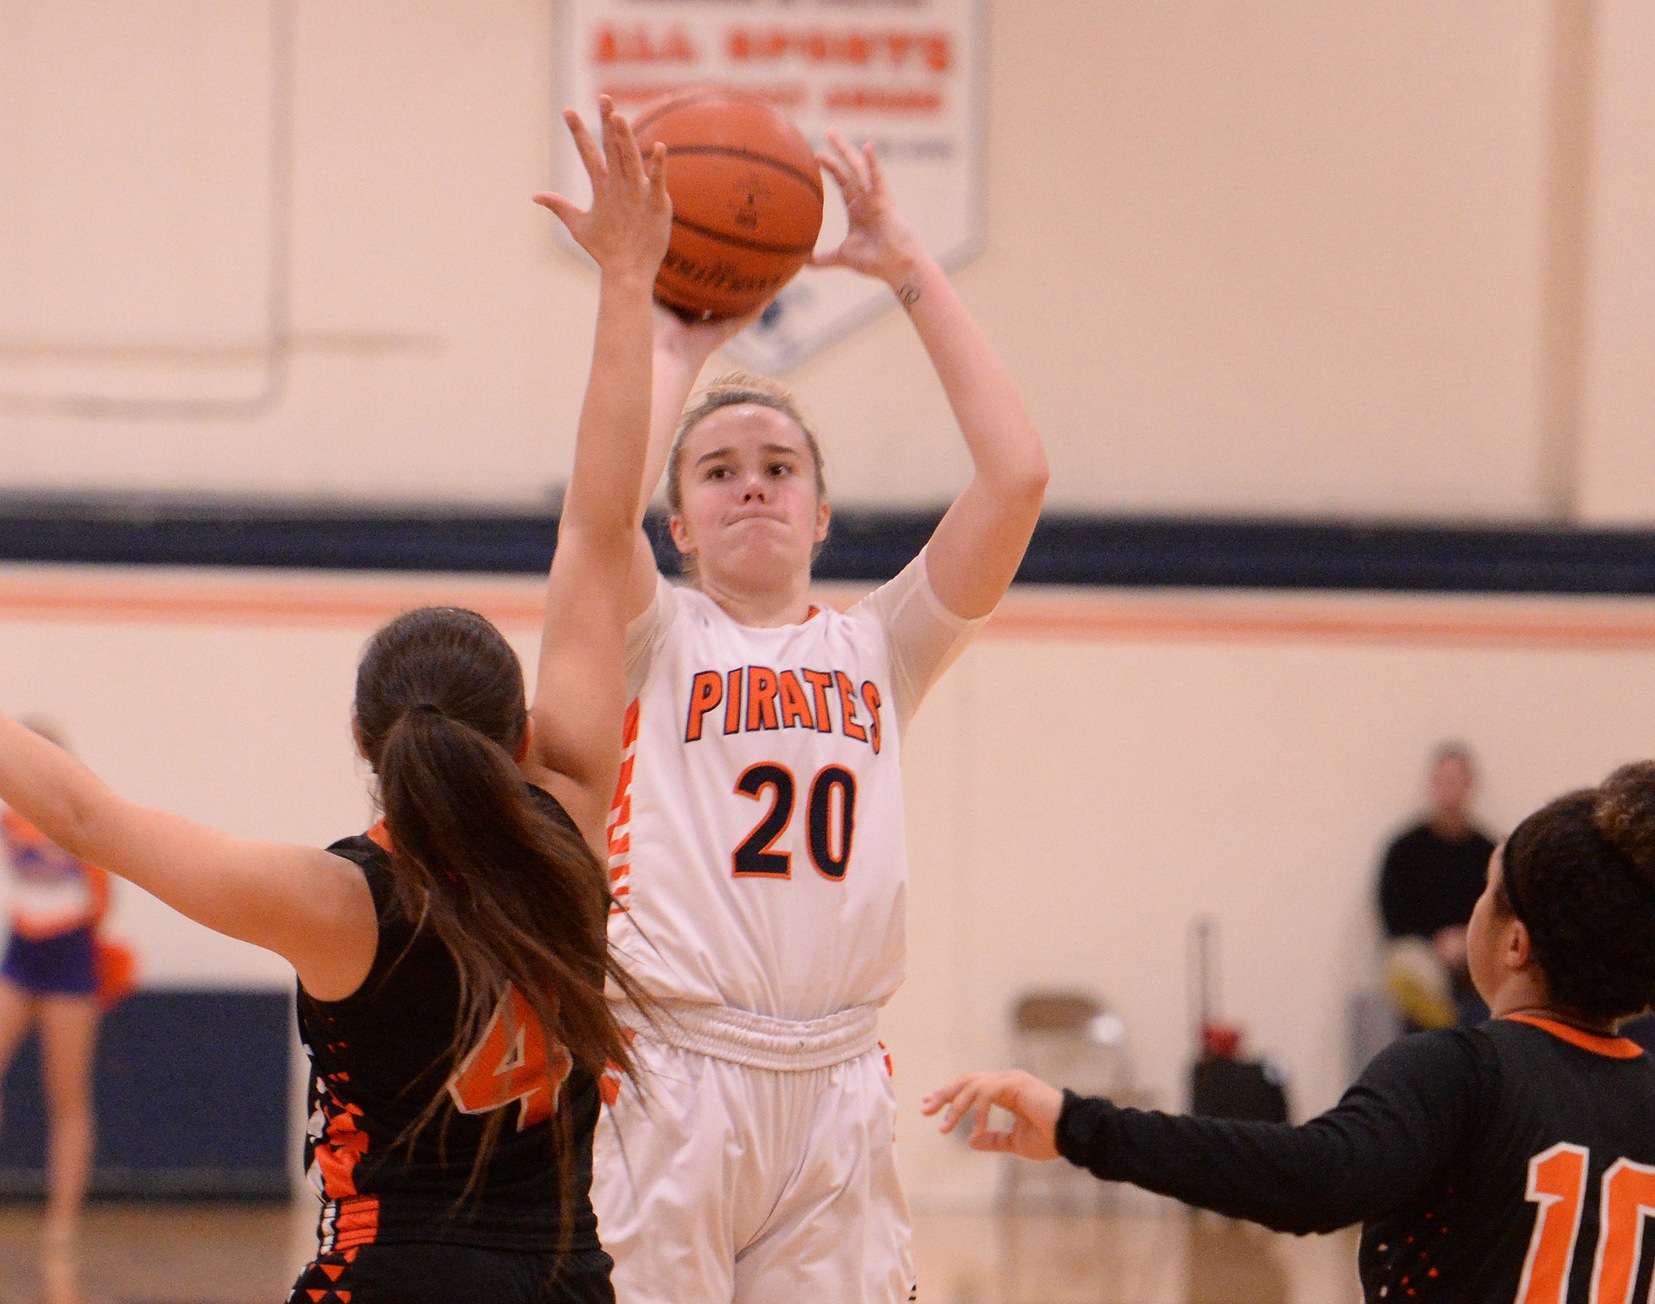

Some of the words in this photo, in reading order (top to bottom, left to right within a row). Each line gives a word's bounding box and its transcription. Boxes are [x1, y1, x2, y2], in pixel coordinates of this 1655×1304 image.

[684, 664, 882, 756] PIRATES
[731, 760, 858, 882] 20
[446, 979, 573, 1133] 4
